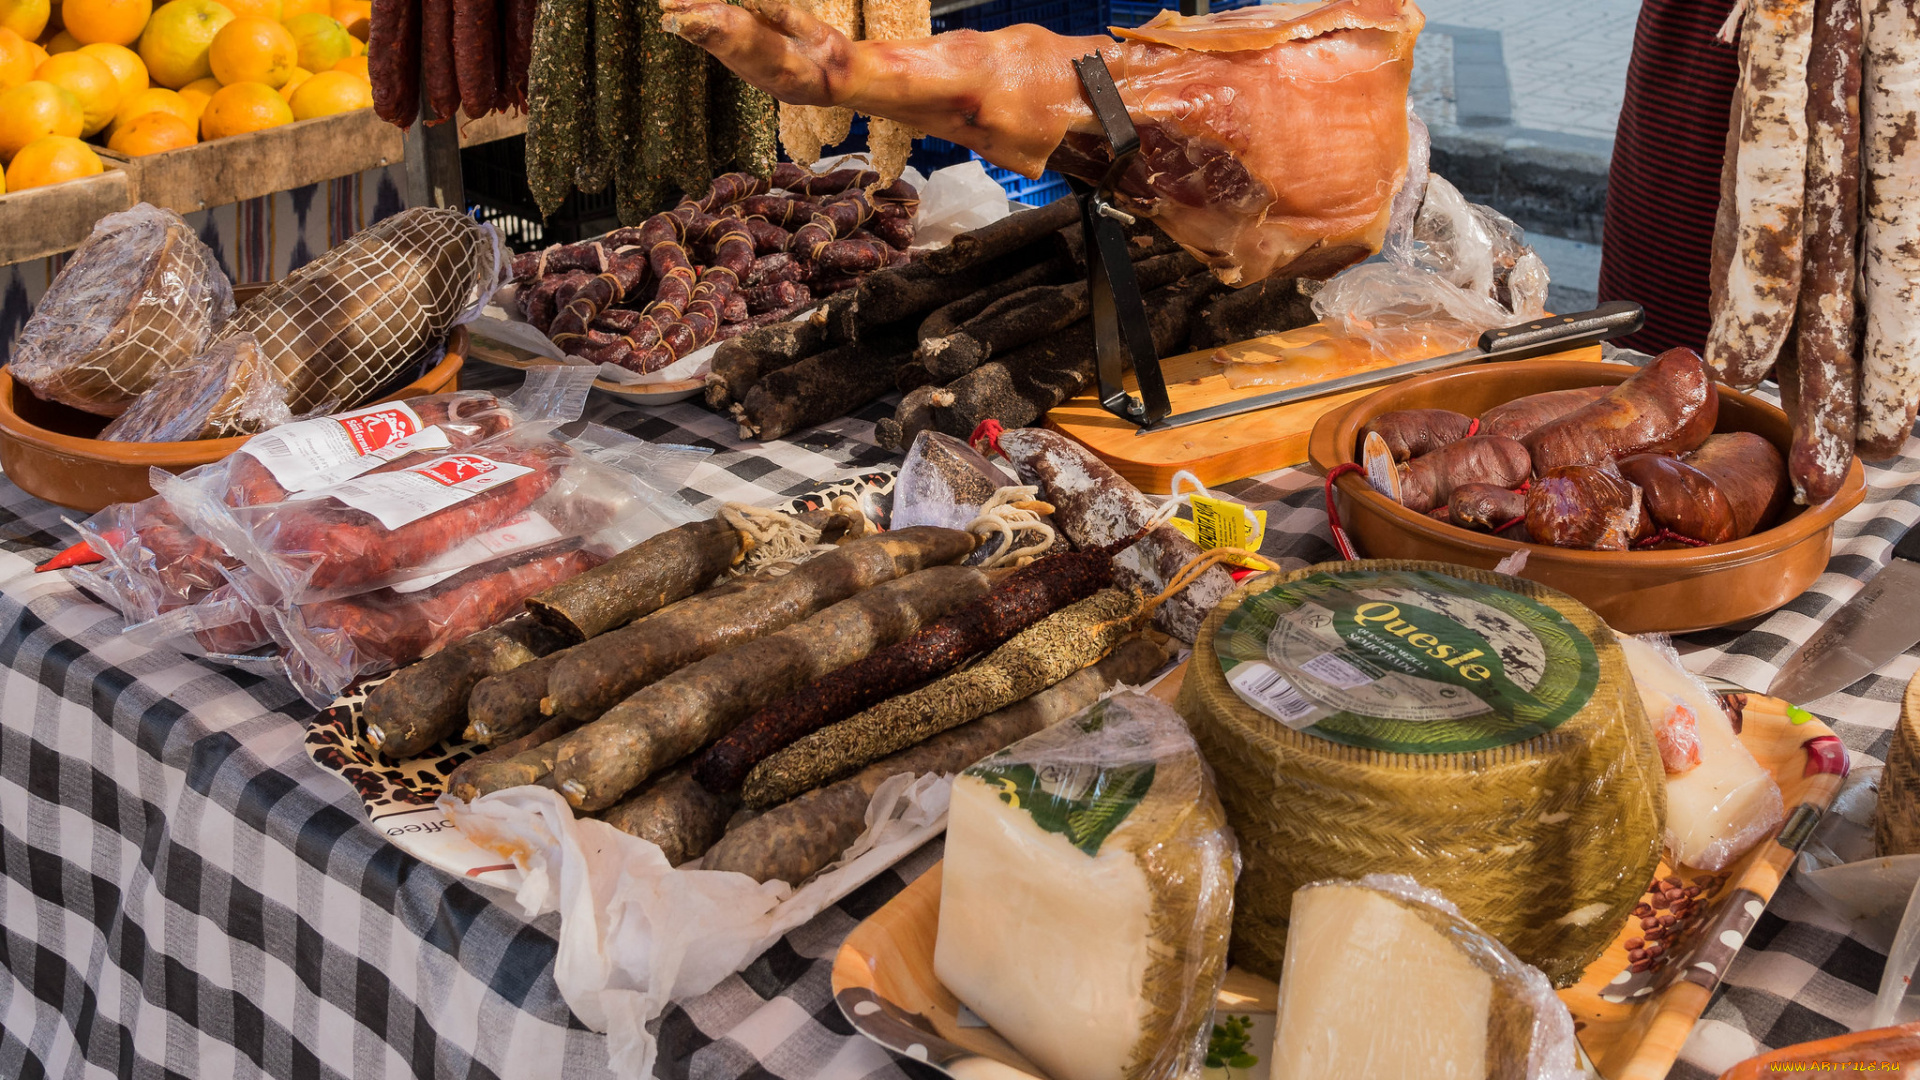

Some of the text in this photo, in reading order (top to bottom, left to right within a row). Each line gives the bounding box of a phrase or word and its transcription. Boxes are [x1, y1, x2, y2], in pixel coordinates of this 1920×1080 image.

[1347, 633, 1417, 674] SEMICURADO
[1353, 602, 1491, 681] Quesle
[1358, 628, 1385, 644] QUESO
[1384, 639, 1398, 652] DE
[1398, 647, 1429, 671] MEZCLA
